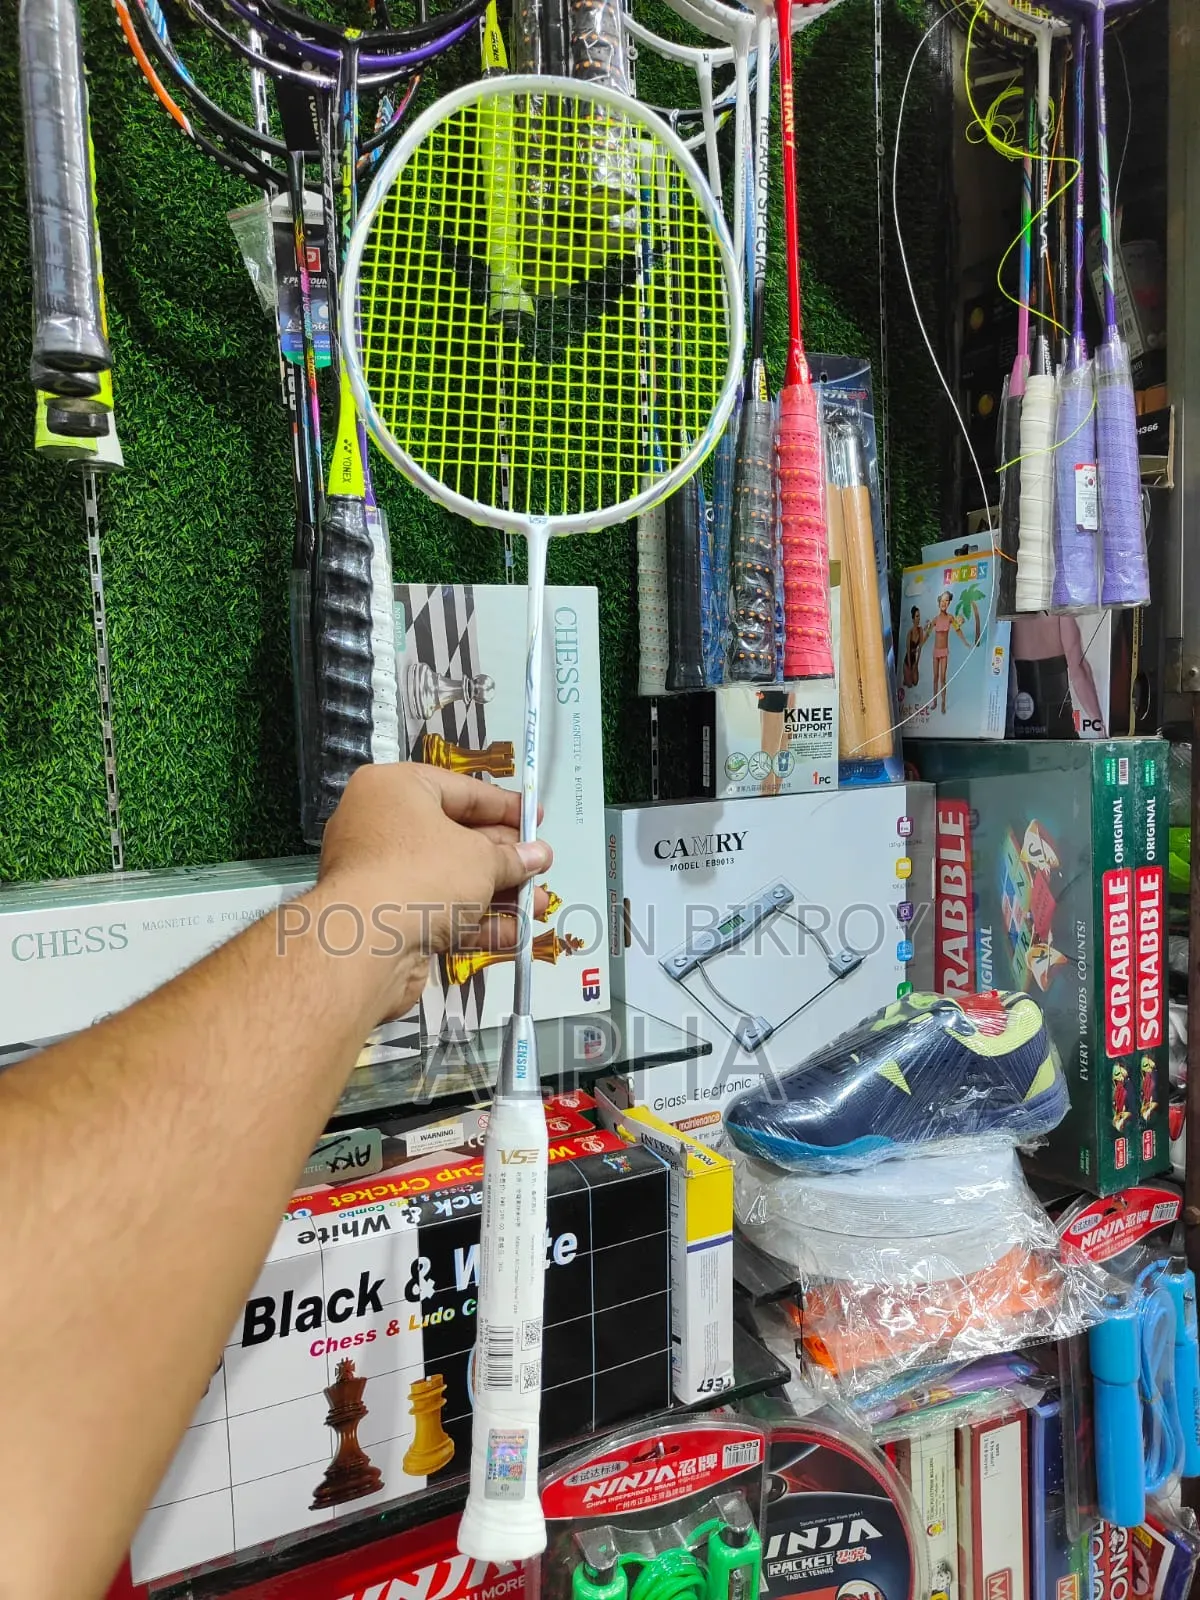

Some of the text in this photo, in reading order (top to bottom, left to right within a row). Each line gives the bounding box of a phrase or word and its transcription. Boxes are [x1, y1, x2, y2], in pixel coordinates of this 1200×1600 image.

[755, 198, 768, 289] SPECIAL
[342, 456, 352, 484] YONEX
[944, 563, 988, 584] INTEX
[554, 606, 580, 705] CHESS
[784, 707, 833, 723] KNEE
[784, 722, 833, 733] SUPPORT
[571, 712, 582, 761] MAGNETIC
[574, 777, 585, 826] FOLDABLE
[653, 831, 749, 860] CAMRY
[1113, 797, 1124, 863] ORIGINAL
[1146, 796, 1156, 861] ORIGINAL
[608, 834, 617, 880] Scale
[938, 811, 969, 998] RABBLE
[142, 915, 200, 931] MAGNETIC
[206, 914, 214, 924] &
[11, 923, 129, 962] CHESS
[980, 925, 993, 993] IGINAL
[1140, 873, 1159, 1041] SCRABBLE
[1109, 876, 1131, 1050] SCRABBLE
[1076, 920, 1089, 1081] EVERY WORDS COUNTS!
[515, 1039, 528, 1080] VENSON
[653, 1078, 752, 1111] Glass Electronic
[679, 1112, 721, 1131] maintenance
[640, 1132, 674, 1156] INTEX
[328, 1178, 431, 1208] Cricket
[434, 1191, 484, 1217] ack
[338, 1204, 385, 1219] Combo
[401, 1206, 423, 1225] &
[297, 1214, 391, 1245] White
[1080, 1218, 1126, 1251] NINJA
[242, 1231, 578, 1348] Black & Wte
[309, 1329, 377, 1358] Chess
[385, 1319, 401, 1336] &
[408, 1305, 455, 1331] Ludo
[582, 1465, 675, 1502] NINJA
[586, 1481, 676, 1509] CHINA INDEPENDENT BRAND
[764, 1519, 884, 1560] INJA
[337, 1554, 518, 1600] INJA
[769, 1553, 834, 1577] RACKET
[785, 1568, 834, 1582] TABLE TENNIS
[482, 1575, 526, 1600] MORE
